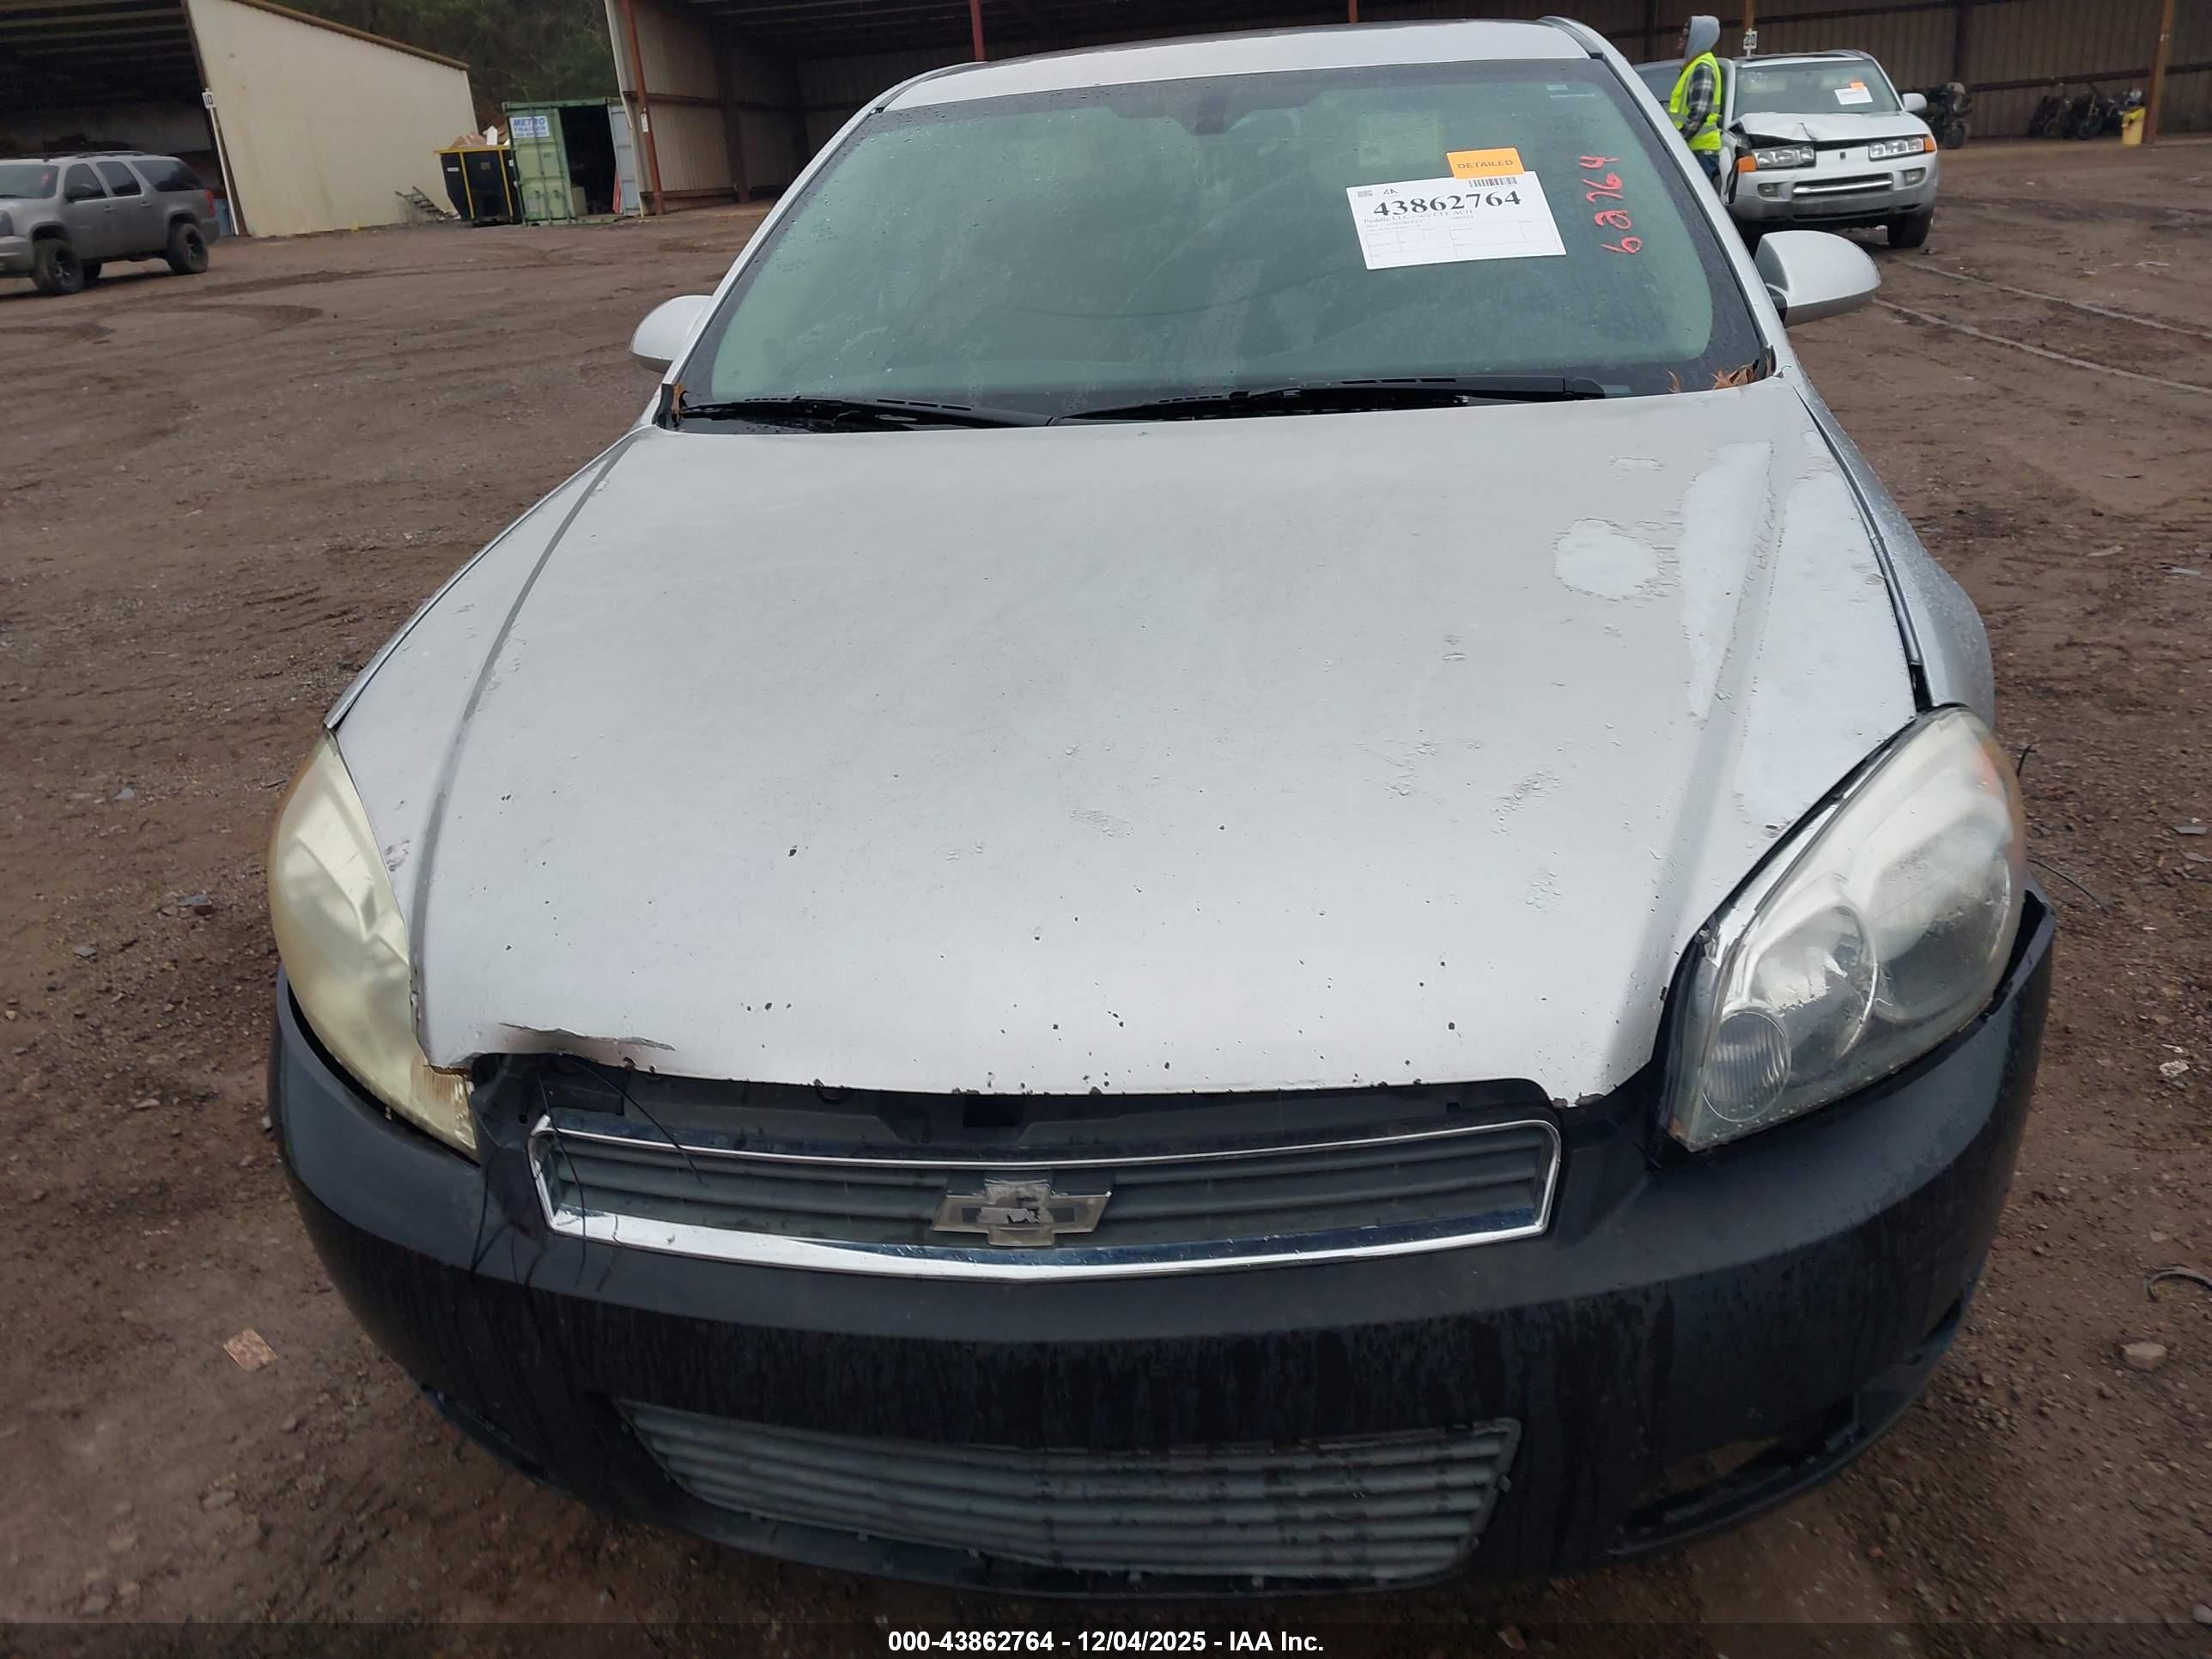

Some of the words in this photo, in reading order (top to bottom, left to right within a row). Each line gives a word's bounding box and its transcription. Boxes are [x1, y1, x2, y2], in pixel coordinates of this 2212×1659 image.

[514, 118, 545, 127] METRO
[1457, 160, 1513, 169] DETAILED
[1373, 190, 1522, 216] 43862764
